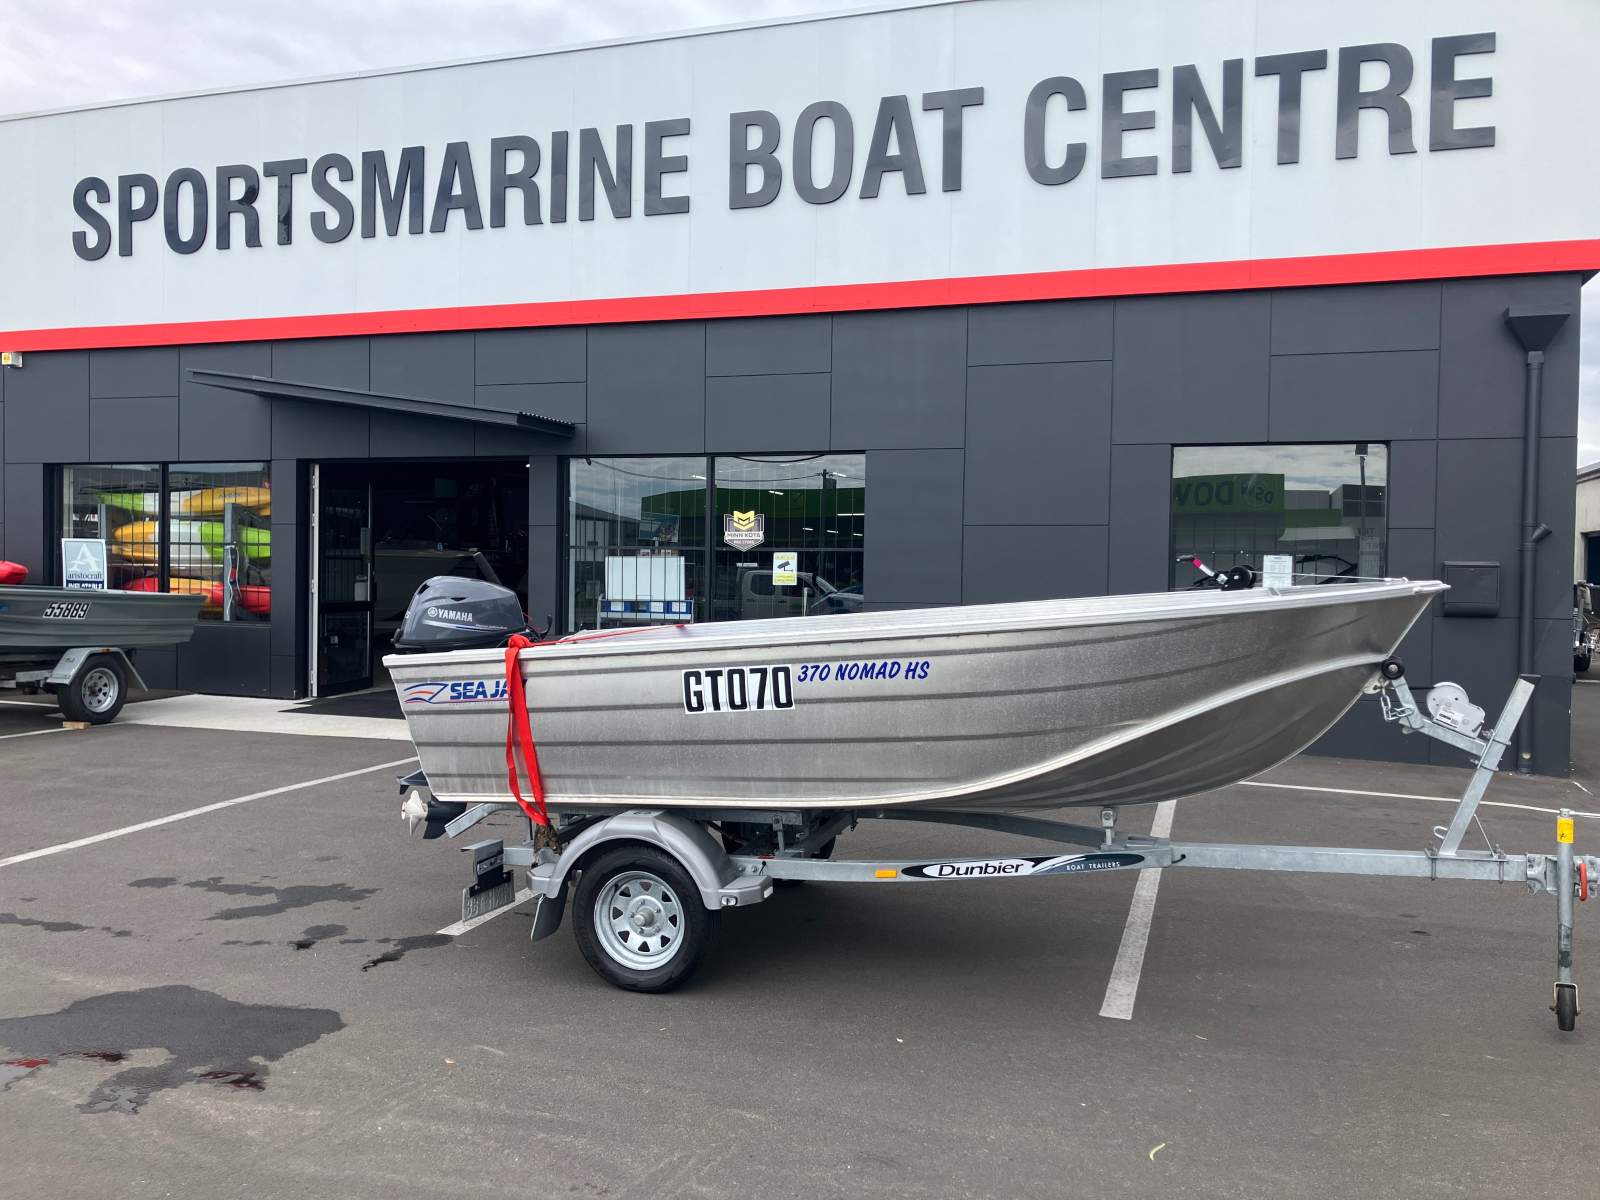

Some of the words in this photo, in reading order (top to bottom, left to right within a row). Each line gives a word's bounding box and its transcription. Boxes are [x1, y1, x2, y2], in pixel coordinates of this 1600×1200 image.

[72, 118, 691, 261] SPORTSMARINE
[729, 87, 984, 209] BOAT
[1024, 31, 1496, 186] CENTRE
[67, 571, 102, 580] aristocraft
[44, 602, 89, 618] 55889
[438, 608, 473, 622] YAMAHA
[797, 664, 831, 682] 370
[835, 661, 901, 681] NOMAD
[904, 660, 930, 679] HS
[449, 681, 489, 700] SEA
[937, 862, 1024, 877] Dunbier
[1066, 863, 1085, 871] BOAT
[1088, 861, 1120, 869] TRAILERS
